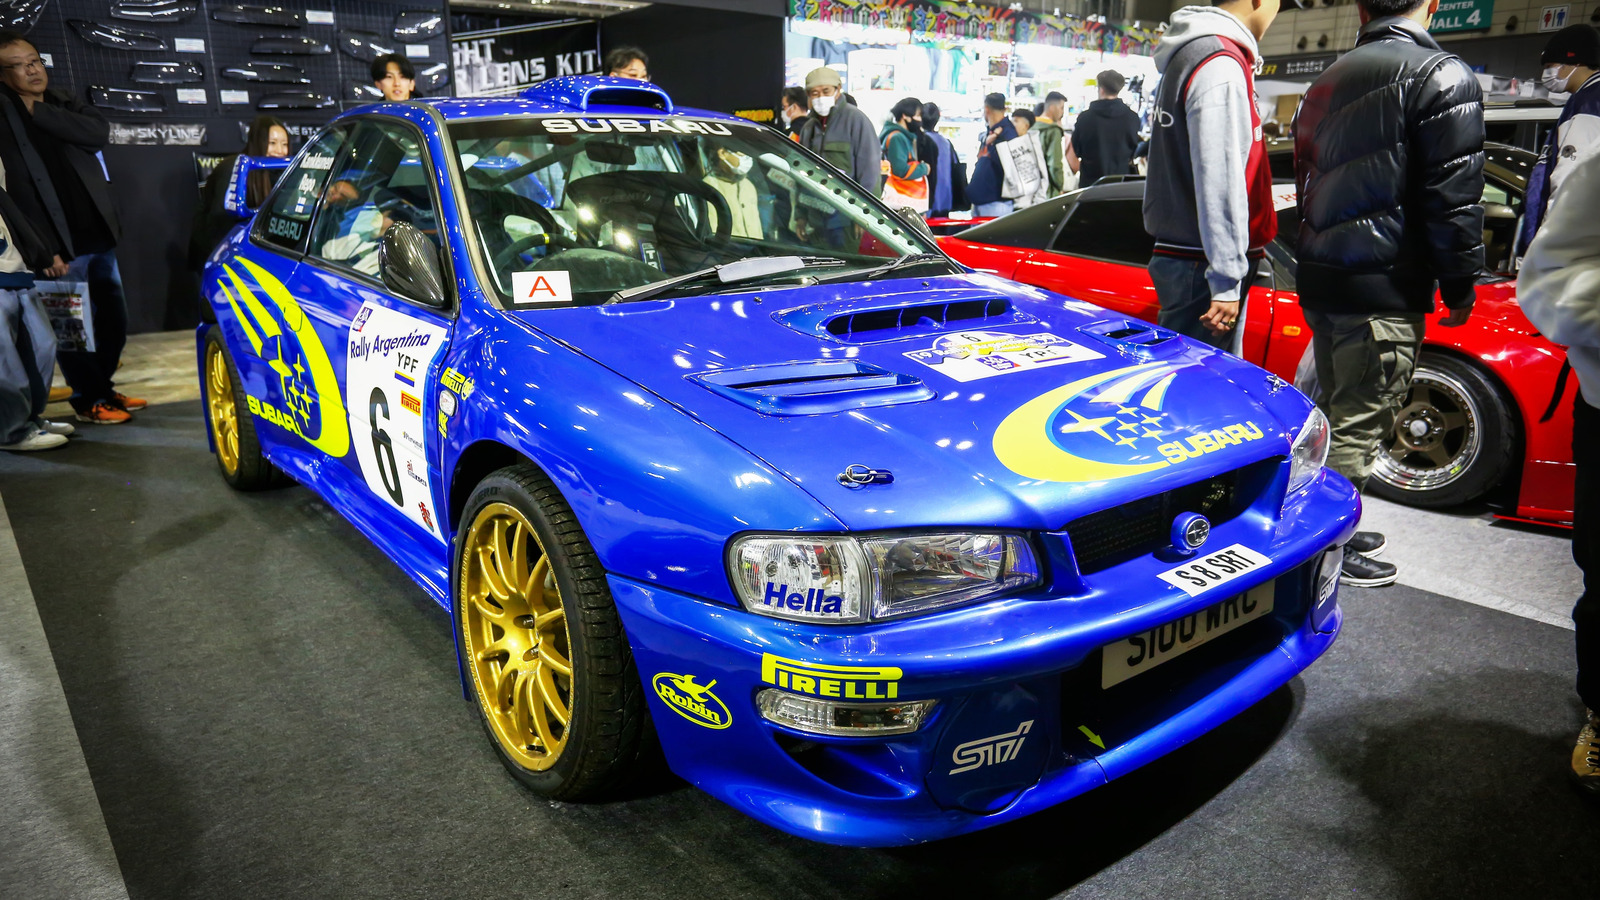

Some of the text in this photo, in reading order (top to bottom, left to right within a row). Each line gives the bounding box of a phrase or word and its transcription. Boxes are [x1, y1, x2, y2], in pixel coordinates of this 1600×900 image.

[1438, 1, 1474, 11] CENTER
[1466, 9, 1481, 26] 4
[480, 57, 547, 90] LENS
[555, 50, 597, 77] KIT
[138, 127, 201, 139] SKYLINE
[541, 118, 733, 136] SUBARU
[268, 217, 303, 240] SUBARU
[528, 276, 557, 298] A
[350, 328, 431, 361] Rally Argentina
[397, 352, 419, 373] YPF
[401, 392, 421, 414] PIRELLI
[369, 386, 404, 508] 6
[1157, 420, 1265, 465] SUBARU
[1206, 549, 1257, 574] SRT
[763, 582, 843, 614] Hella
[761, 652, 904, 699] PIRELLI
[658, 682, 723, 726] Robin
